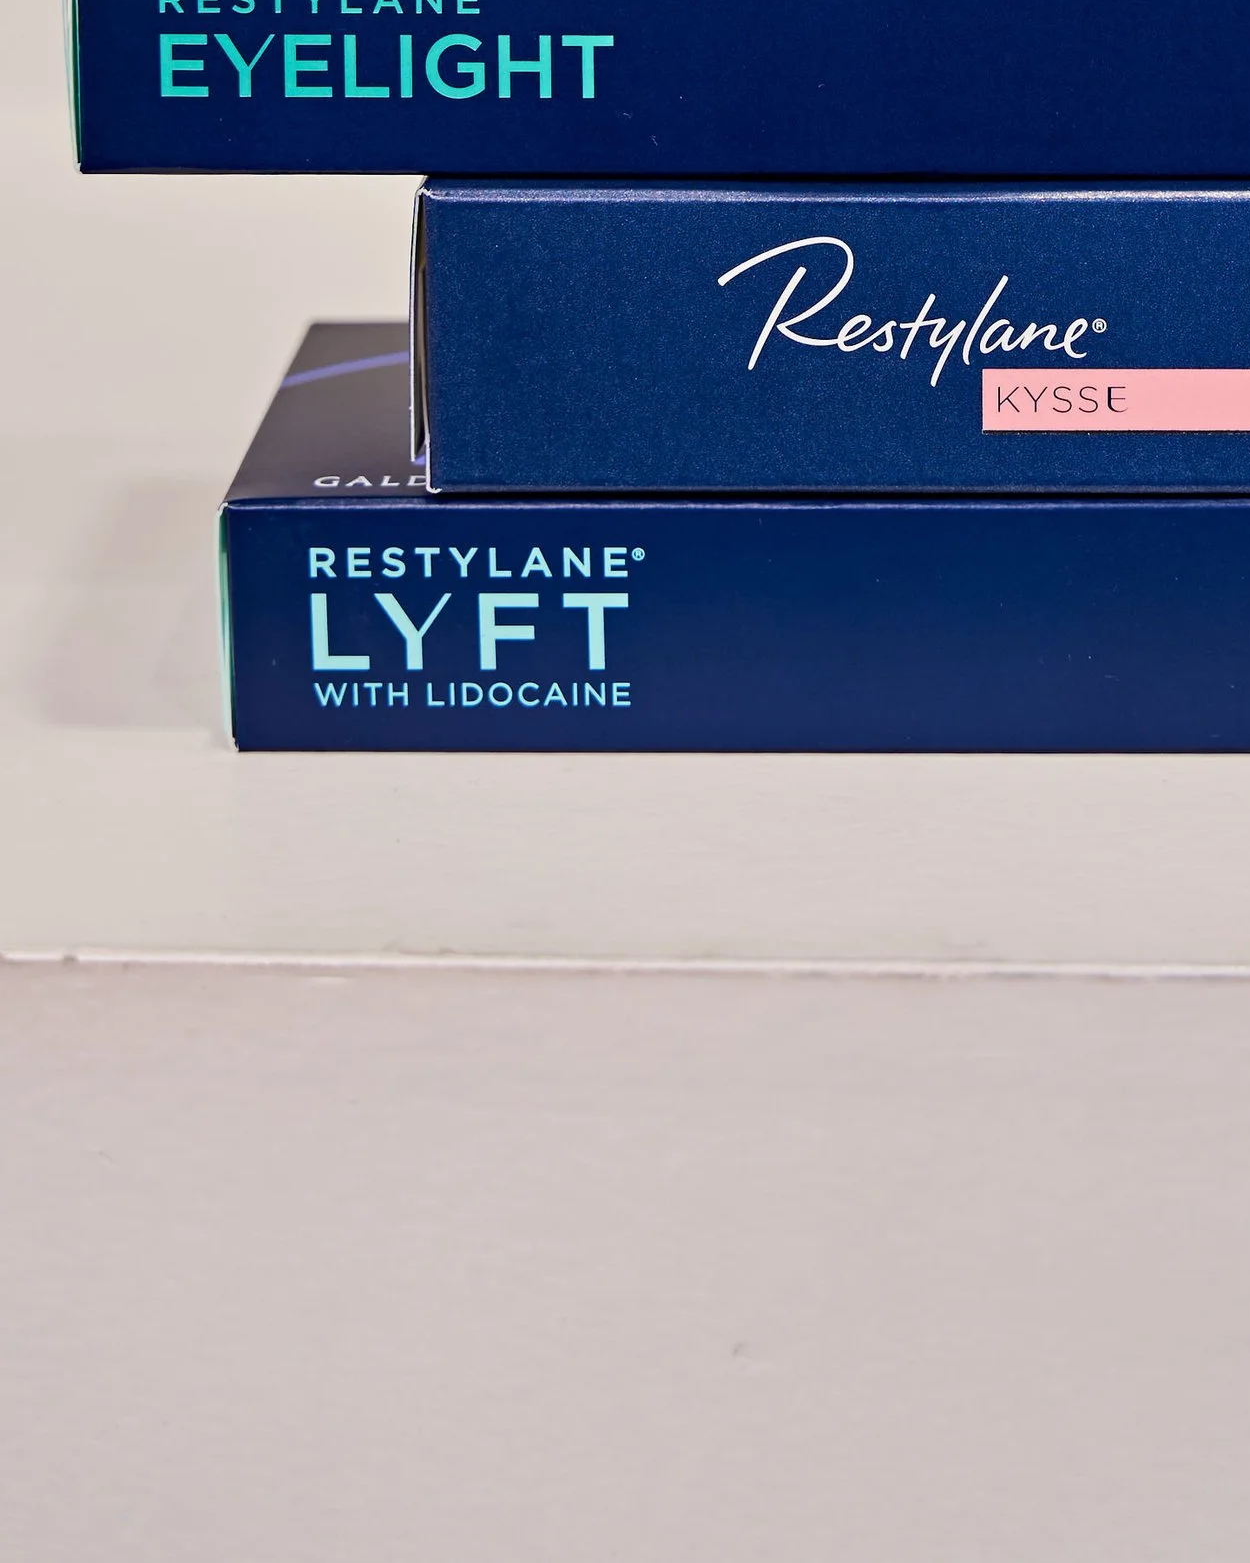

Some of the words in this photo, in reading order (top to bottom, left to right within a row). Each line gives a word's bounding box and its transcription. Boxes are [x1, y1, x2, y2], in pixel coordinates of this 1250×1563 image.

[159, 33, 615, 100] EYELIGHT
[996, 385, 1128, 414] KYSSE
[310, 592, 629, 671] LYFT
[313, 682, 410, 707] WITH
[426, 682, 632, 707] LIDOCAINE
